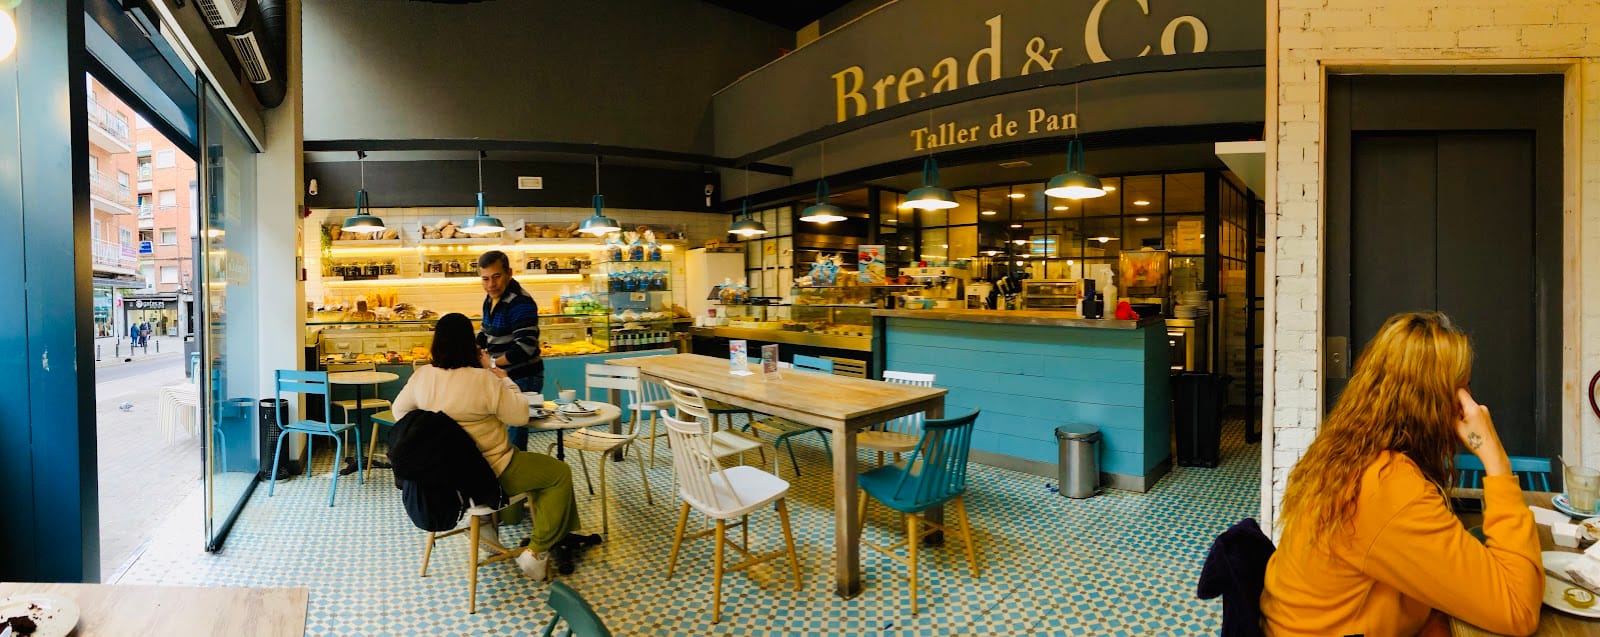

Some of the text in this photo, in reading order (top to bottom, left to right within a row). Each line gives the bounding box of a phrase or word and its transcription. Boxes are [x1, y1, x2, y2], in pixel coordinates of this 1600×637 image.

[831, 0, 1209, 123] Bread & Co
[911, 108, 1078, 151] Taller de Pan
